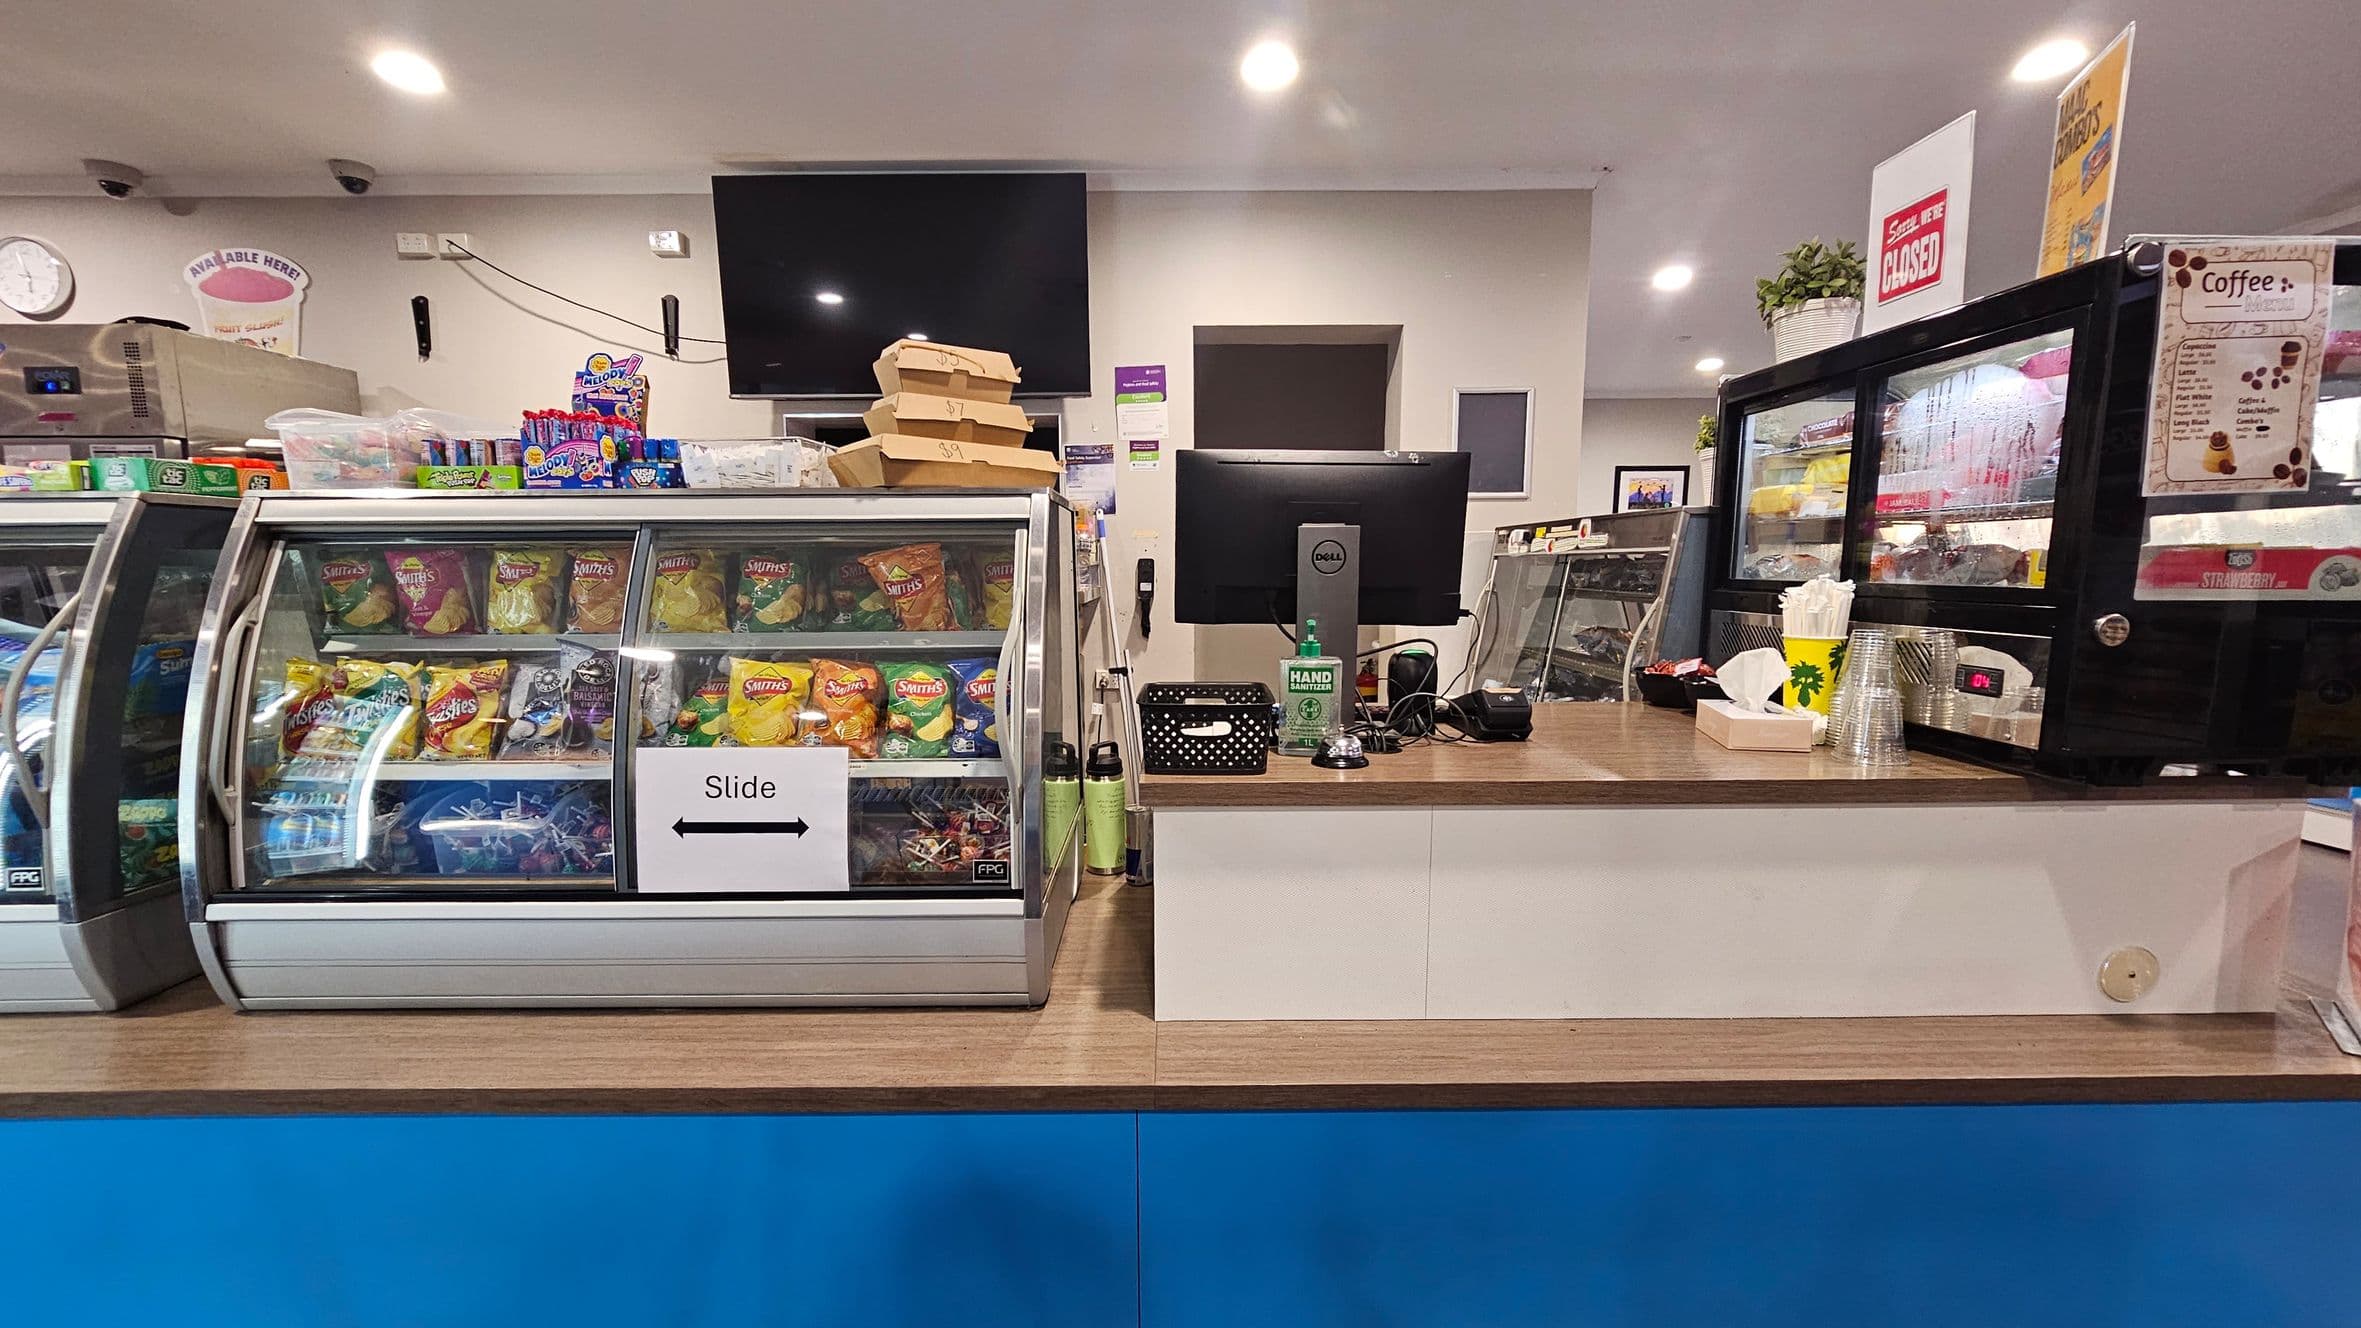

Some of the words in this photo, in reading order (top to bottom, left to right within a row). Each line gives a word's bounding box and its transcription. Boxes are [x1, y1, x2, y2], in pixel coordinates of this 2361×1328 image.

[1887, 213, 1920, 246] Sorry
[1920, 201, 1946, 227] WE'RE
[189, 251, 259, 278] AVAILABLE
[263, 255, 301, 281] HERE!
[1881, 231, 1940, 294] CLOSED
[2202, 269, 2275, 298] Coffee
[2245, 296, 2295, 312] Menu
[583, 367, 627, 386] MELODY
[945, 400, 965, 417] $7
[1807, 418, 1838, 432] CHOCOLATE
[938, 442, 964, 460] $9
[163, 467, 184, 476] tic
[528, 453, 571, 478] MELODY
[163, 475, 184, 485] tac
[252, 475, 270, 483] tic
[1315, 553, 1342, 562] DELL
[572, 559, 615, 577] SMITH'S
[841, 563, 867, 578] SMIT
[985, 564, 1015, 577] SMIT
[395, 569, 437, 586] SMITH'S
[2202, 572, 2277, 588] STRAWBERRY
[886, 577, 922, 597] SMITH'S
[1290, 671, 1332, 683] HAND
[744, 679, 789, 694] SMITH'S
[826, 678, 866, 696] SMITH'S
[897, 680, 944, 695] SMITH'S
[1290, 683, 1332, 691] SANITIZER
[573, 691, 613, 701] BALSAMIC
[283, 698, 335, 736] Twisties
[425, 697, 478, 725] Twisties
[705, 775, 776, 799] Slide
[10, 871, 39, 883] FPG
[978, 864, 1004, 875] FPG
